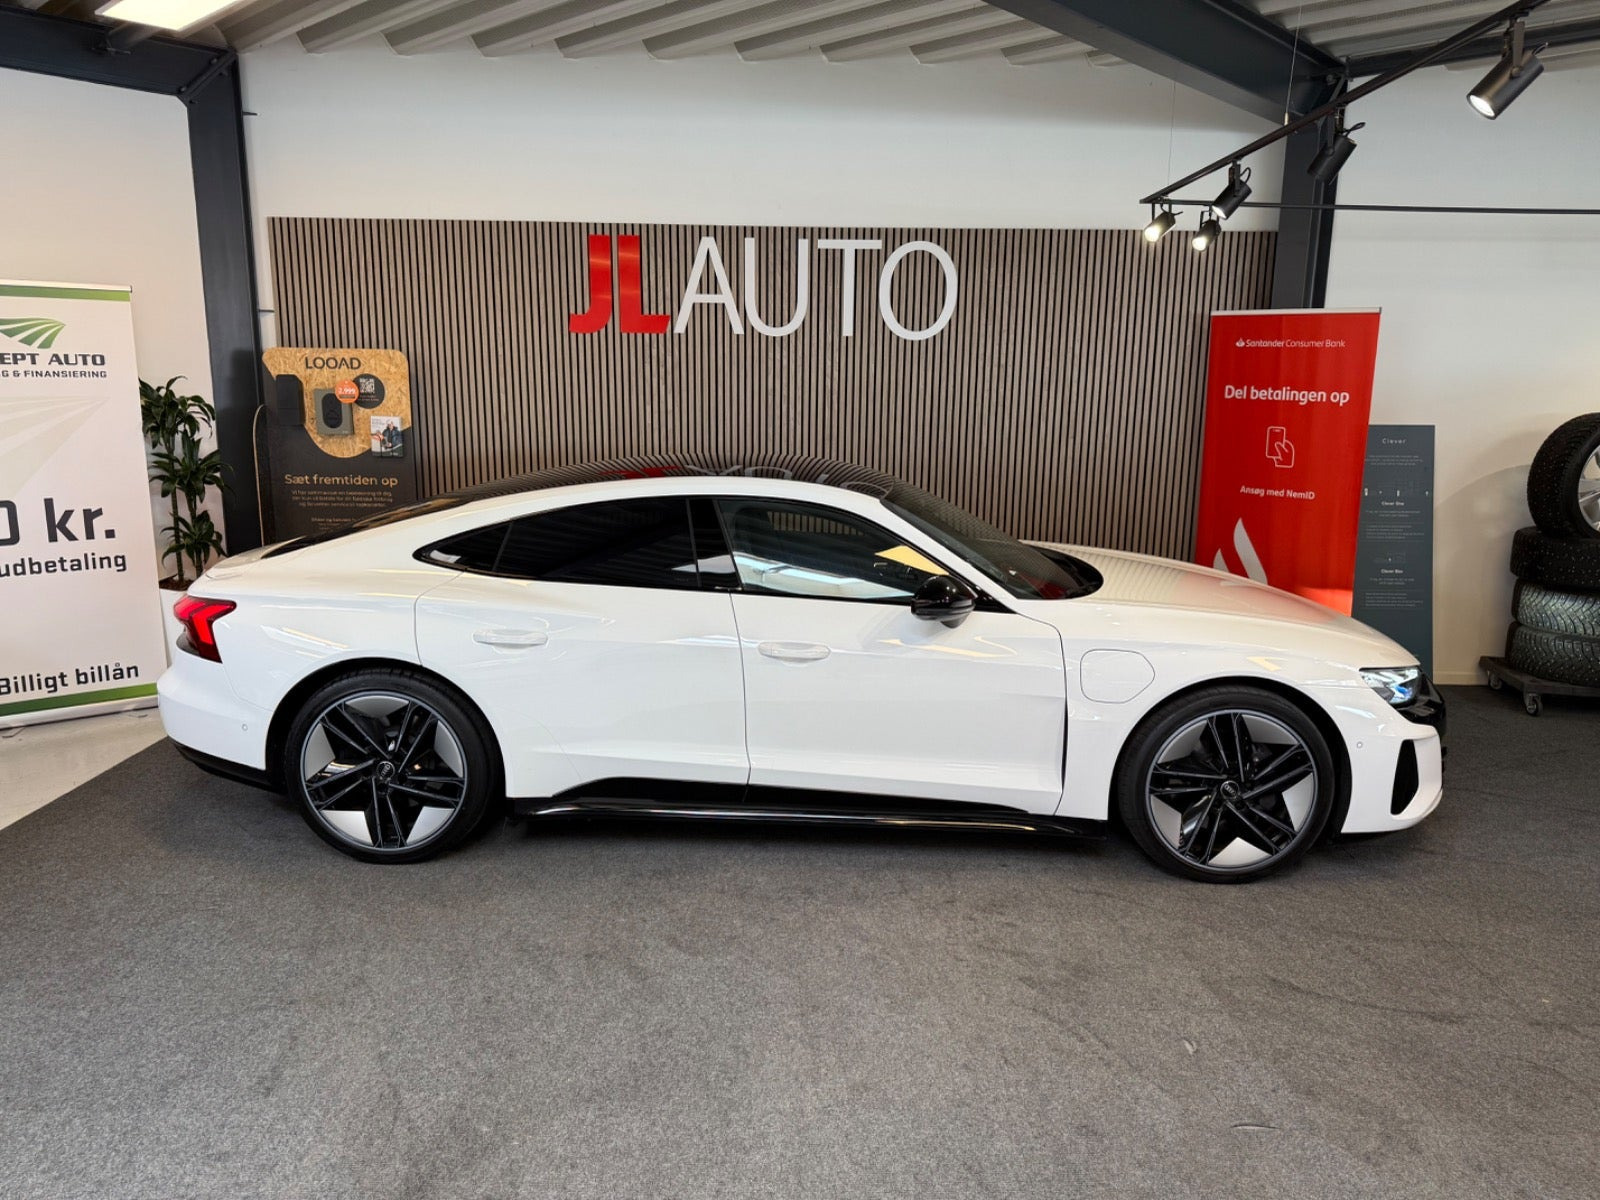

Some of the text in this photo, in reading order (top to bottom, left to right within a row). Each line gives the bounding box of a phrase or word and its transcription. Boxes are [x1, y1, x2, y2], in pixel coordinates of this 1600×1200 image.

[1245, 339, 1346, 348] Santander Consumer Bank
[0, 352, 106, 366] EPT AUTO
[304, 356, 362, 370] LOOAD
[23, 370, 108, 379] FINANSIERING
[1224, 385, 1350, 406] Del betalingen op
[284, 473, 399, 488] Sæt fremtiden op
[1240, 485, 1316, 500] Ansøg med NemID
[43, 497, 117, 543] kr.
[0, 552, 127, 578] udbetaling
[0, 662, 140, 696] Billigt billån
